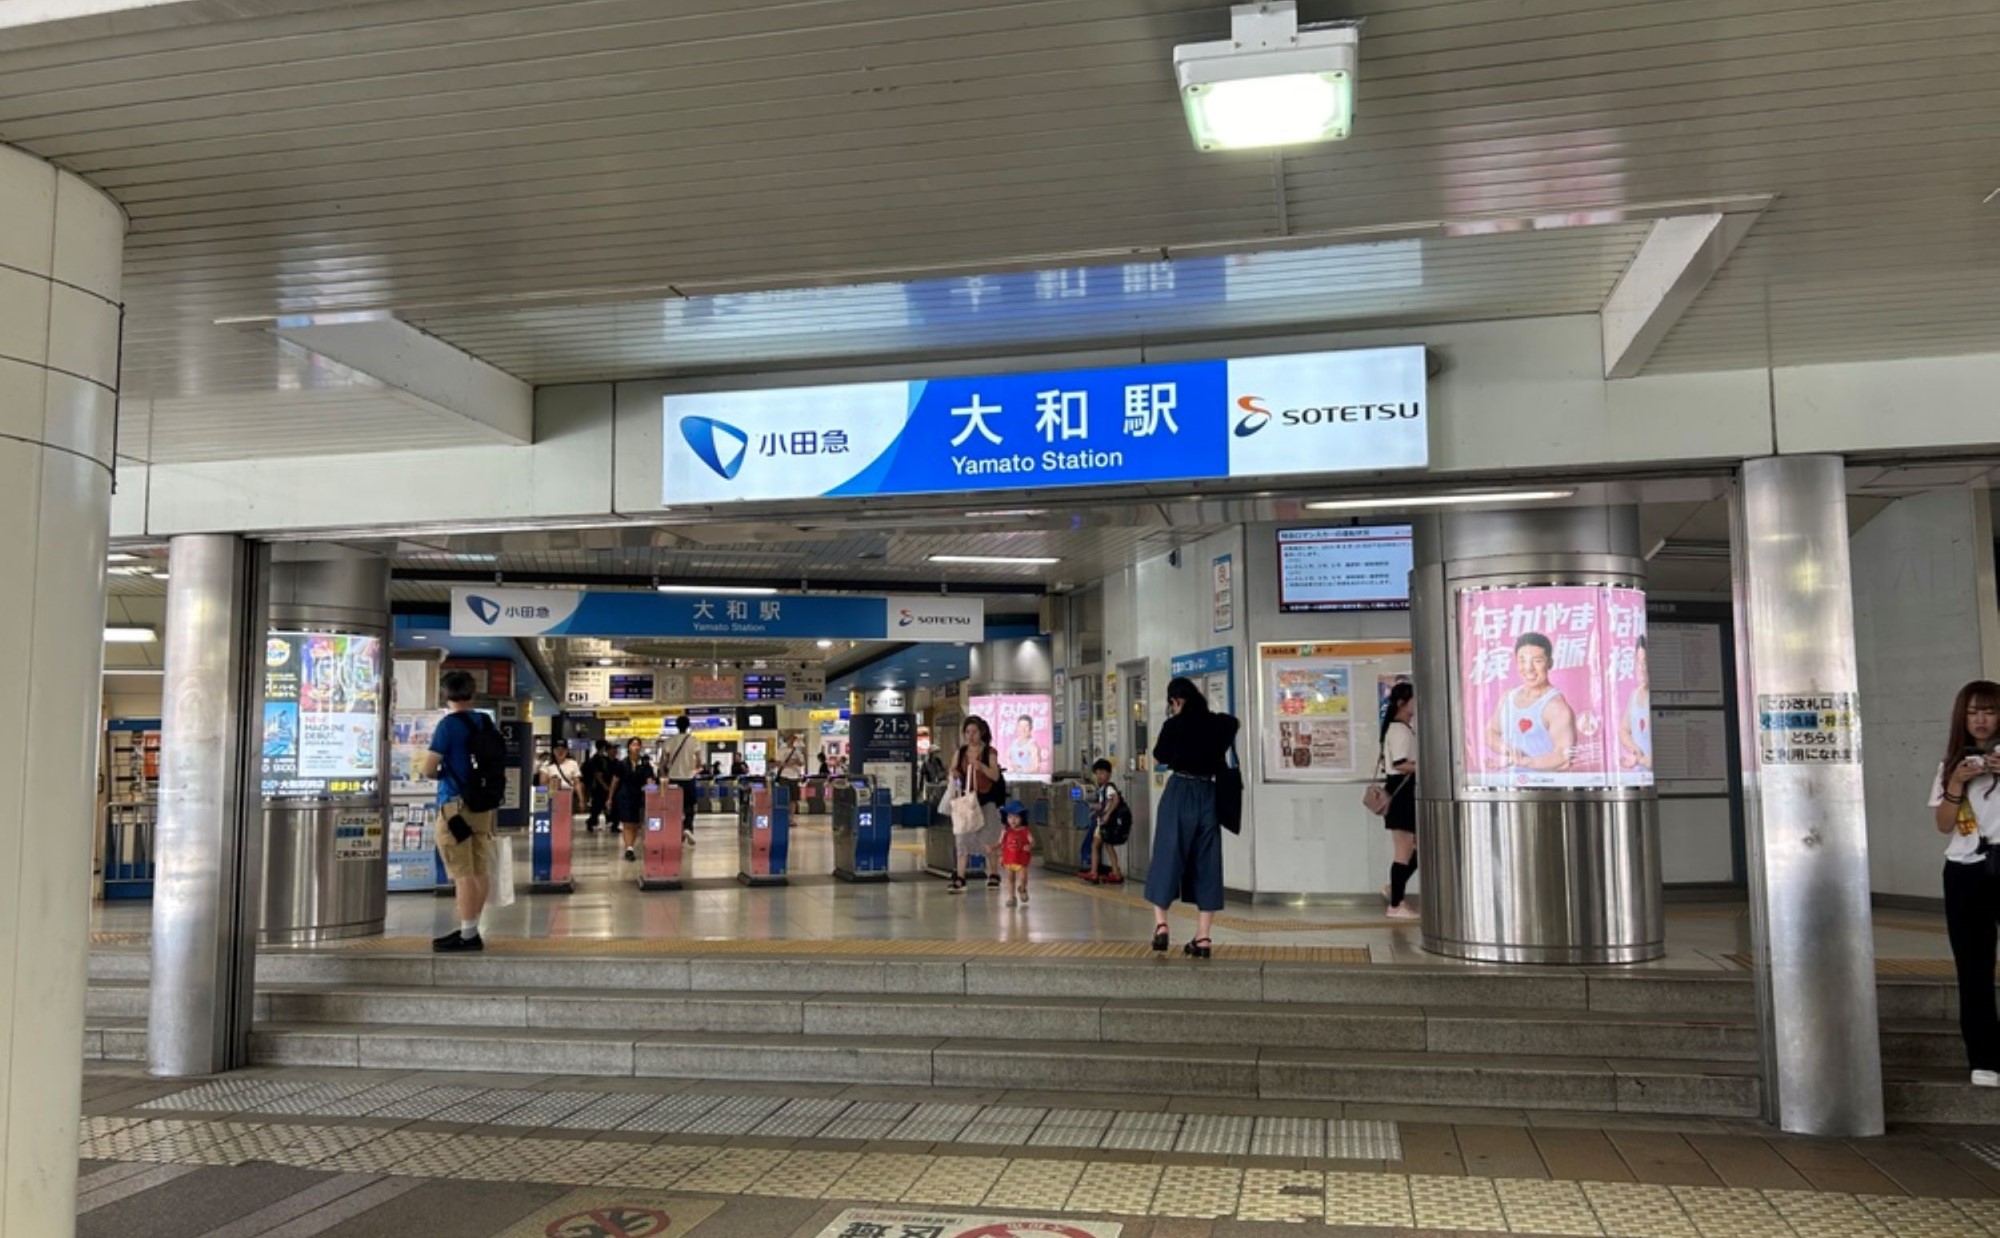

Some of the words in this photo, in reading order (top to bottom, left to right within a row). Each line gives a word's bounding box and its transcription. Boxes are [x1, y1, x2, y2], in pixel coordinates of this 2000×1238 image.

[950, 381, 1179, 447] 大和駅
[1282, 401, 1420, 426] SOTETSU
[759, 429, 850, 457] 小田急
[951, 453, 1035, 475] Yamato
[1041, 448, 1123, 471] Station
[504, 605, 550, 619] 小田急
[692, 599, 781, 621] 大和駅
[917, 615, 971, 625] SOTETSU
[1471, 602, 1595, 640] なかやま
[693, 622, 730, 631] Yamato
[731, 622, 766, 632] Station
[1791, 731, 1837, 745] どちらも
